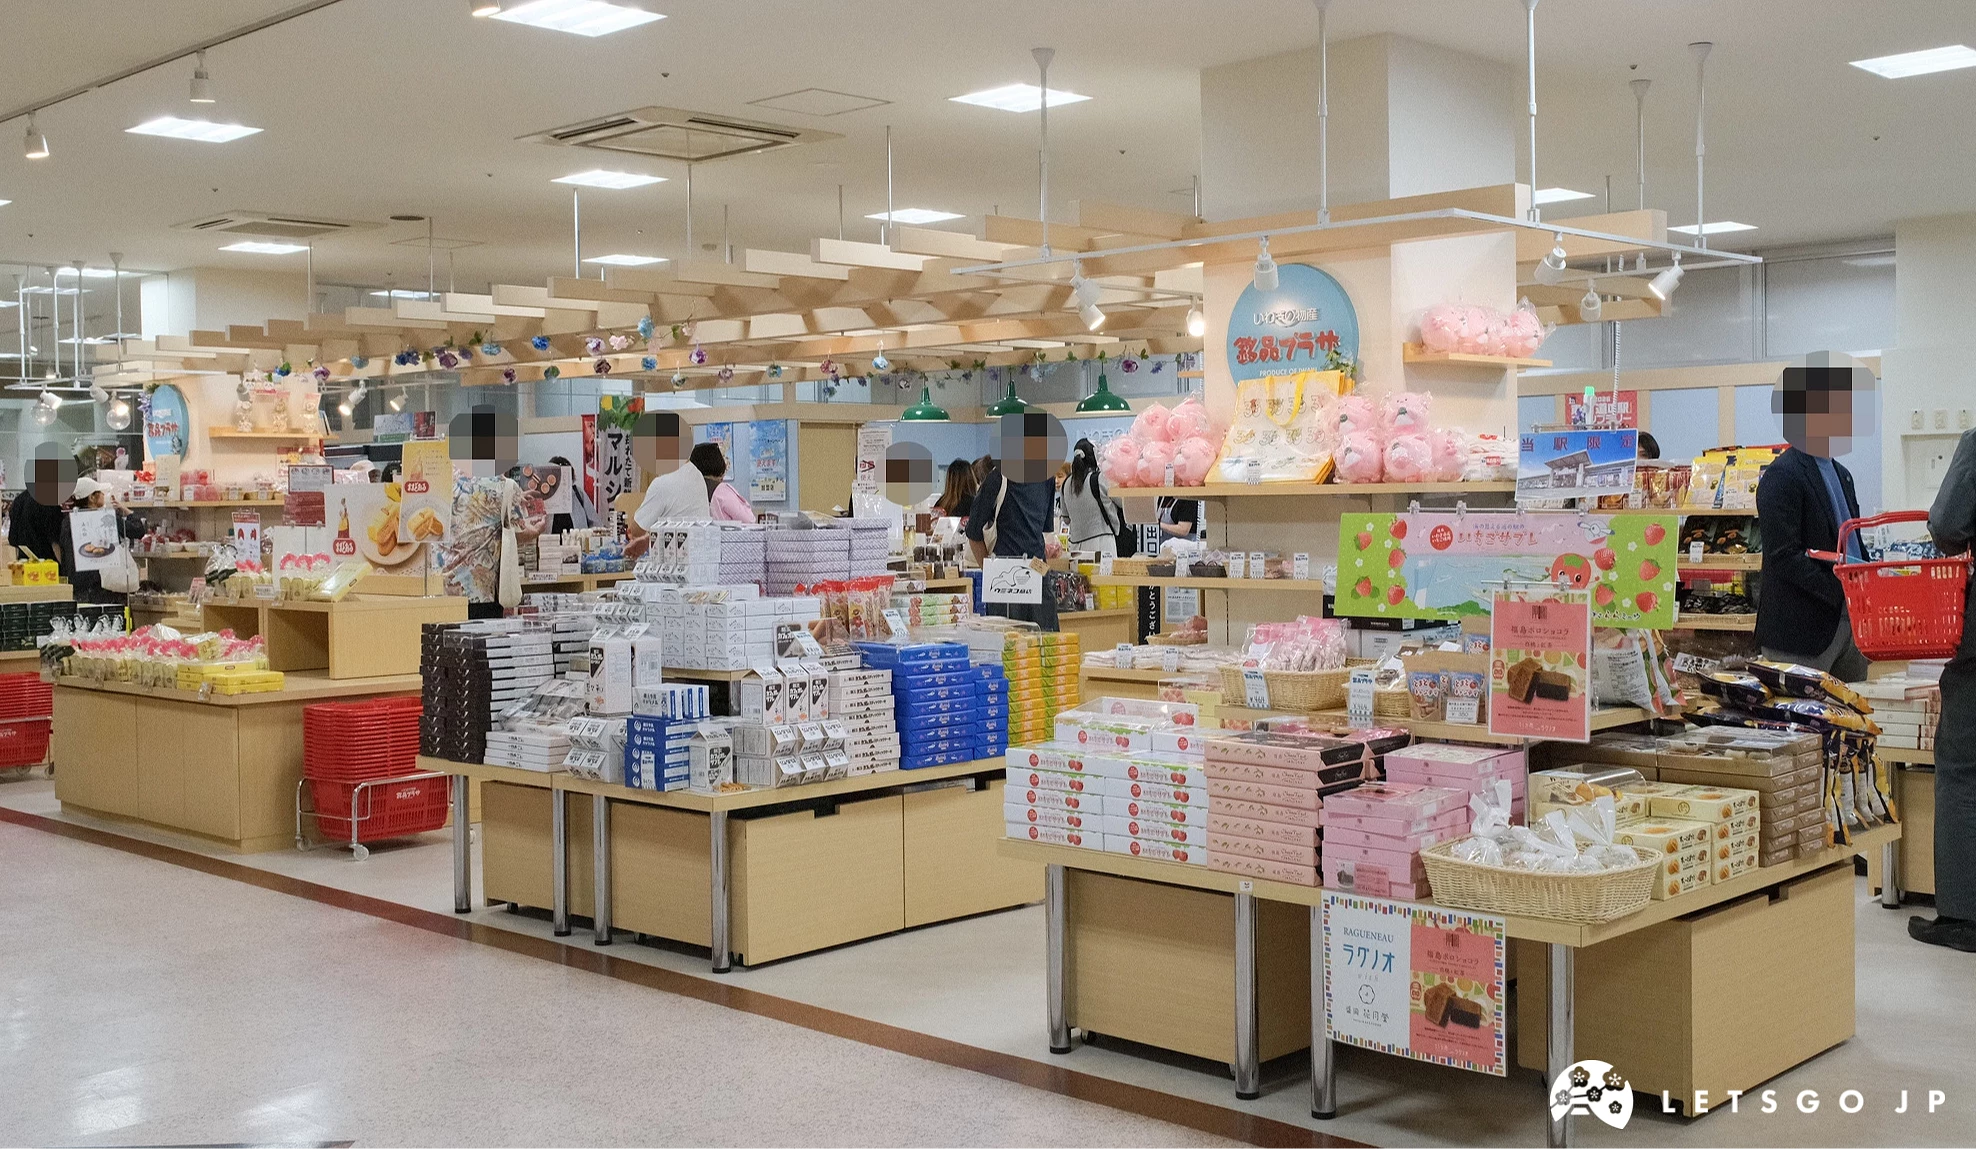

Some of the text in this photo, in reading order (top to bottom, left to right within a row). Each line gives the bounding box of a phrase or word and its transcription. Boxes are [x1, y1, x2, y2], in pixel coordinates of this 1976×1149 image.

[1253, 308, 1319, 327] いわきの物産
[1233, 329, 1340, 365] 銘品プラザ
[1259, 367, 1288, 377] PRODUCE
[1521, 435, 1635, 453] 当駅限定
[605, 433, 623, 511] マルシ
[1146, 526, 1157, 554] 出口
[1457, 530, 1538, 547] いちごサブレ
[1343, 927, 1394, 943] RAGUENEAU
[1343, 944, 1395, 973] ラグノオ
